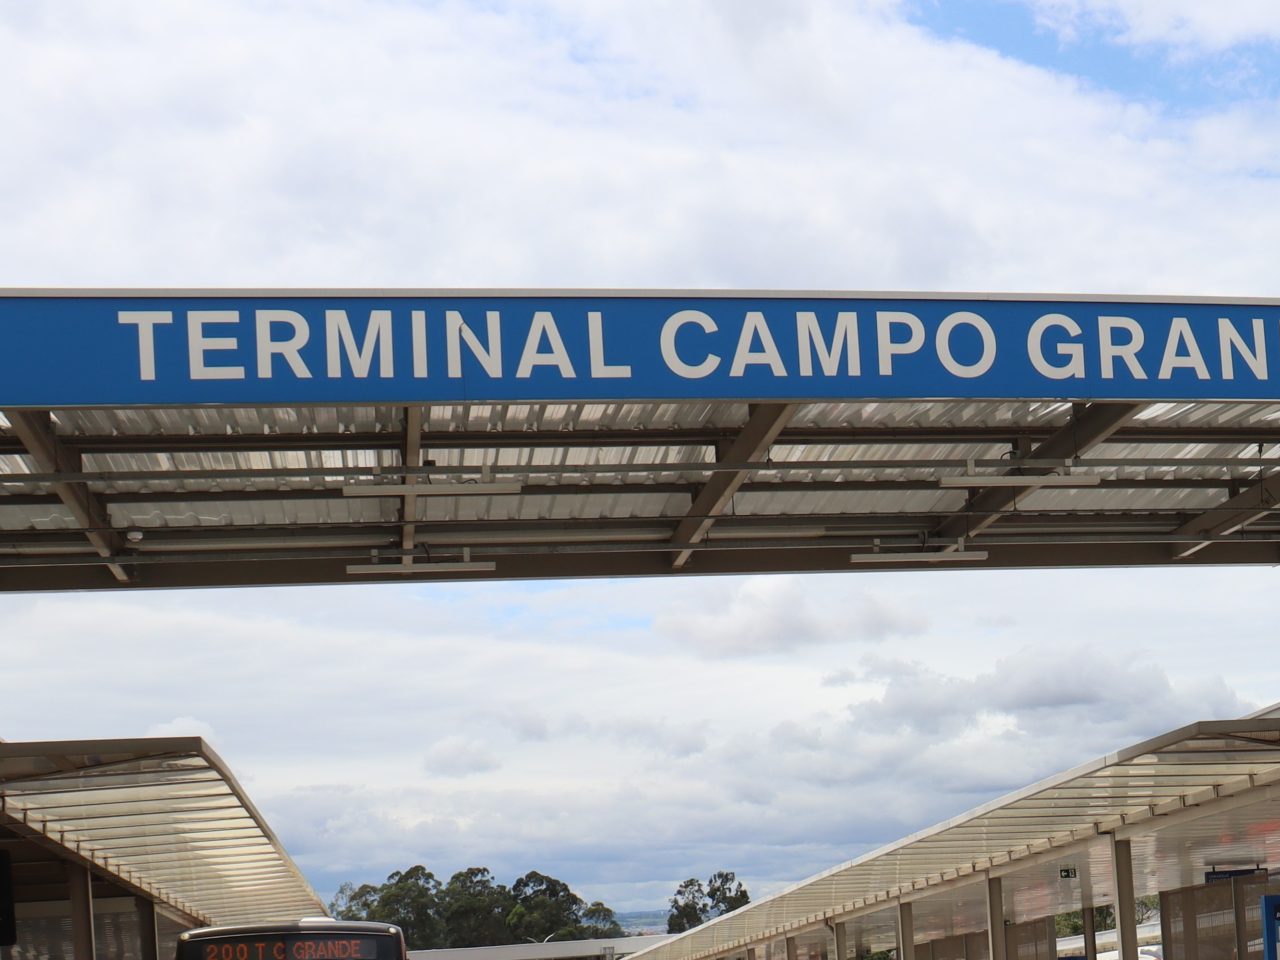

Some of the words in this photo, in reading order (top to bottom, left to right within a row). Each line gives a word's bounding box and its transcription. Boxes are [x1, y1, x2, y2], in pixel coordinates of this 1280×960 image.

[117, 308, 632, 382] TERMINAL
[659, 309, 998, 380] CAMPO
[273, 941, 287, 960] C
[292, 939, 362, 960] GRANDE
